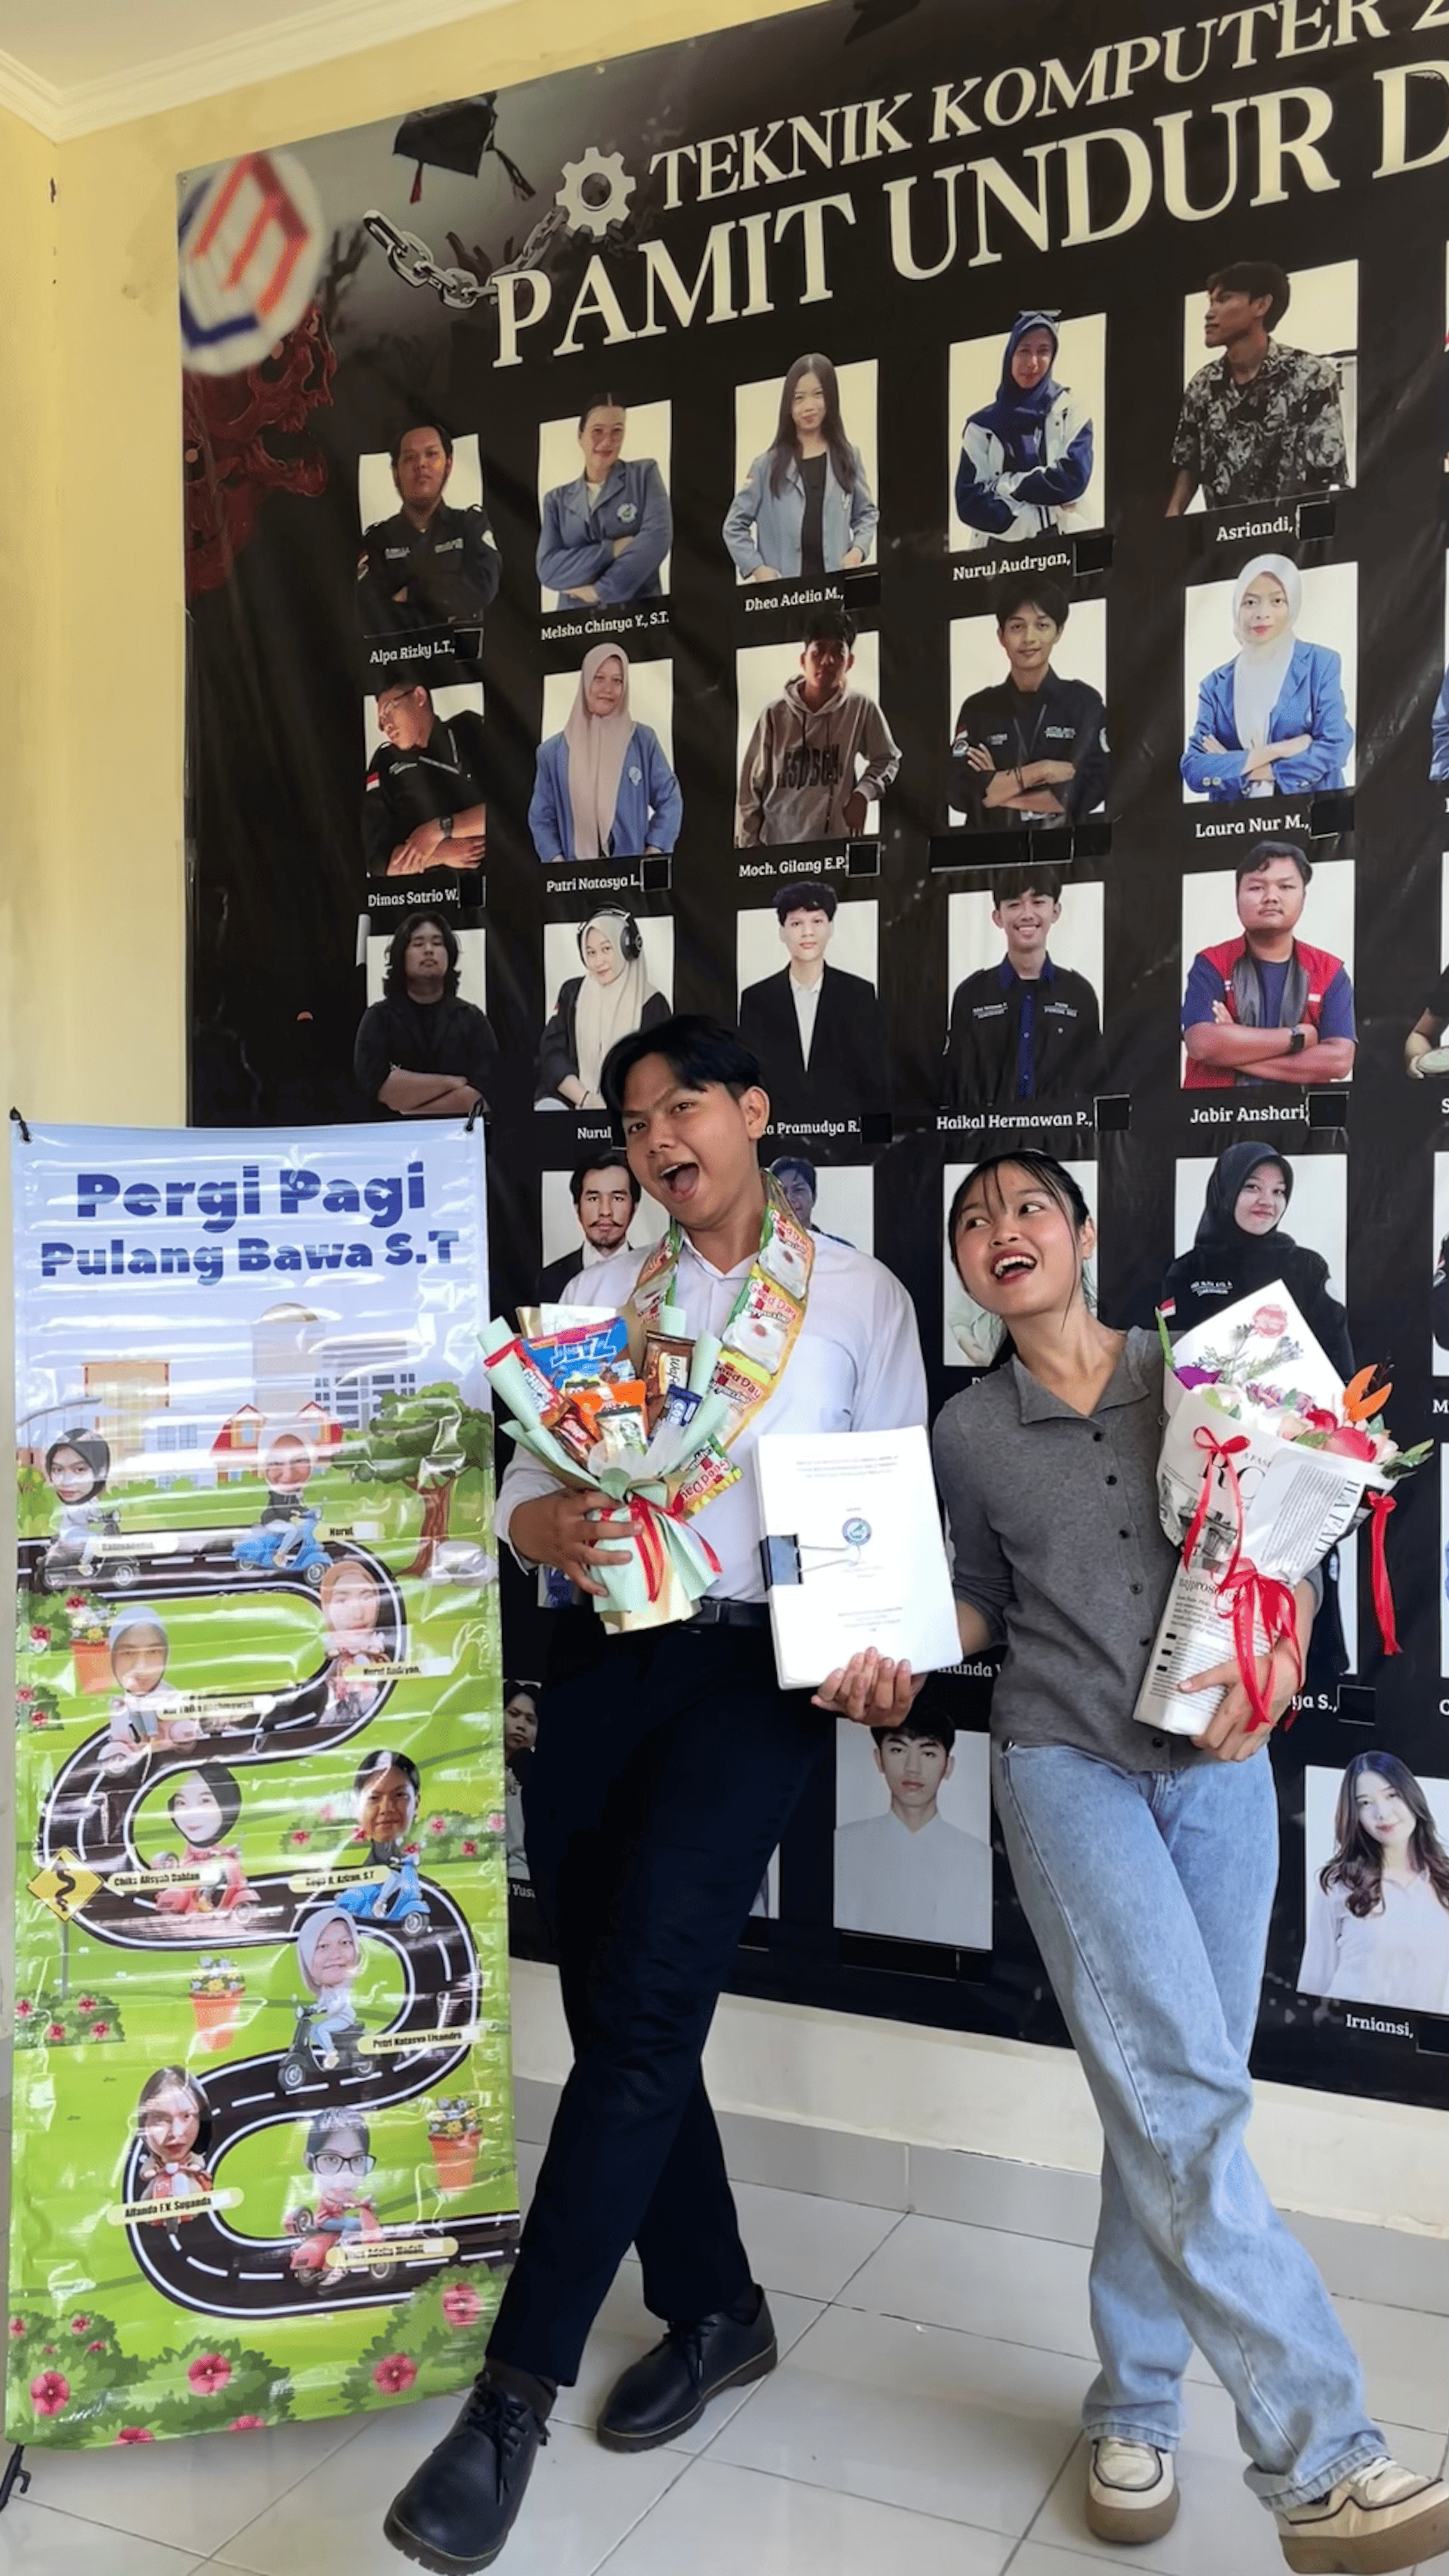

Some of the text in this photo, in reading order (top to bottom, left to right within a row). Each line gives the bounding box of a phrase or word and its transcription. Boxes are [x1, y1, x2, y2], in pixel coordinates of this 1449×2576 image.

[649, 0, 1391, 210] TEKNIK KOMPUTER
[492, 194, 858, 368] PAMIT
[882, 85, 1340, 281] UNDUR
[1216, 518, 1294, 542] Asriandi,
[953, 553, 1071, 580] Nurul Audryan,
[745, 597, 778, 611] Dhea
[781, 591, 822, 608] Adelia
[541, 624, 582, 640] Melsha
[585, 618, 632, 635] Chintya
[650, 611, 669, 625] S.T.
[400, 643, 432, 661] Rizky
[1196, 815, 1310, 838] Laura Nur M.,
[739, 862, 776, 877] Moch.
[779, 859, 822, 877] Gilang
[546, 879, 576, 892] Putri
[578, 877, 628, 893] Natasya
[368, 893, 405, 907] Dimas
[407, 891, 443, 905] Satrio
[937, 1111, 1093, 1130] Haikal Hermawan P.,
[1190, 1104, 1309, 1124] Jabir Anshari,
[578, 1126, 611, 1140] Nurul
[777, 1120, 845, 1138] Pramudya
[847, 1120, 861, 1133] R.
[77, 1160, 425, 1232] Pergi Pagi
[41, 1230, 460, 1286] Pulang Bawa S.T
[1317, 1693, 1338, 1713] S.,
